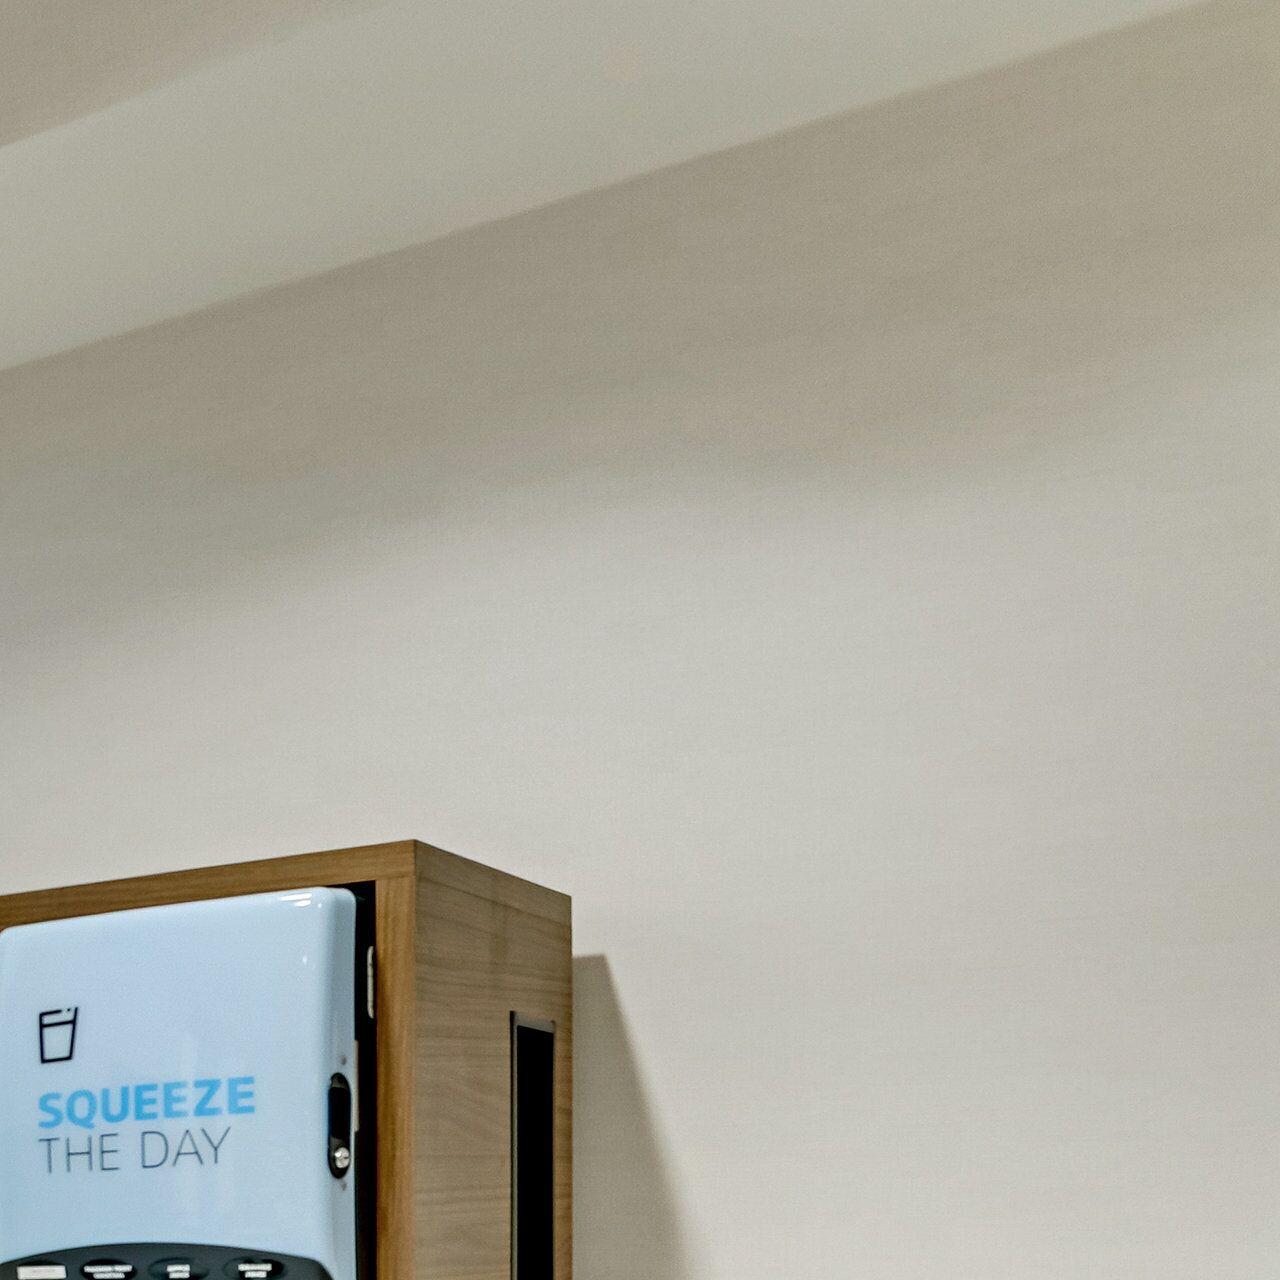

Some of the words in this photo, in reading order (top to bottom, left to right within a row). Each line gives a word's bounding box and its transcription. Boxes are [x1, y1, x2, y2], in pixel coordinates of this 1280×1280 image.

[38, 1075, 256, 1130] SQUEEZE
[38, 1132, 121, 1174] THE
[140, 1126, 232, 1170] DAY
